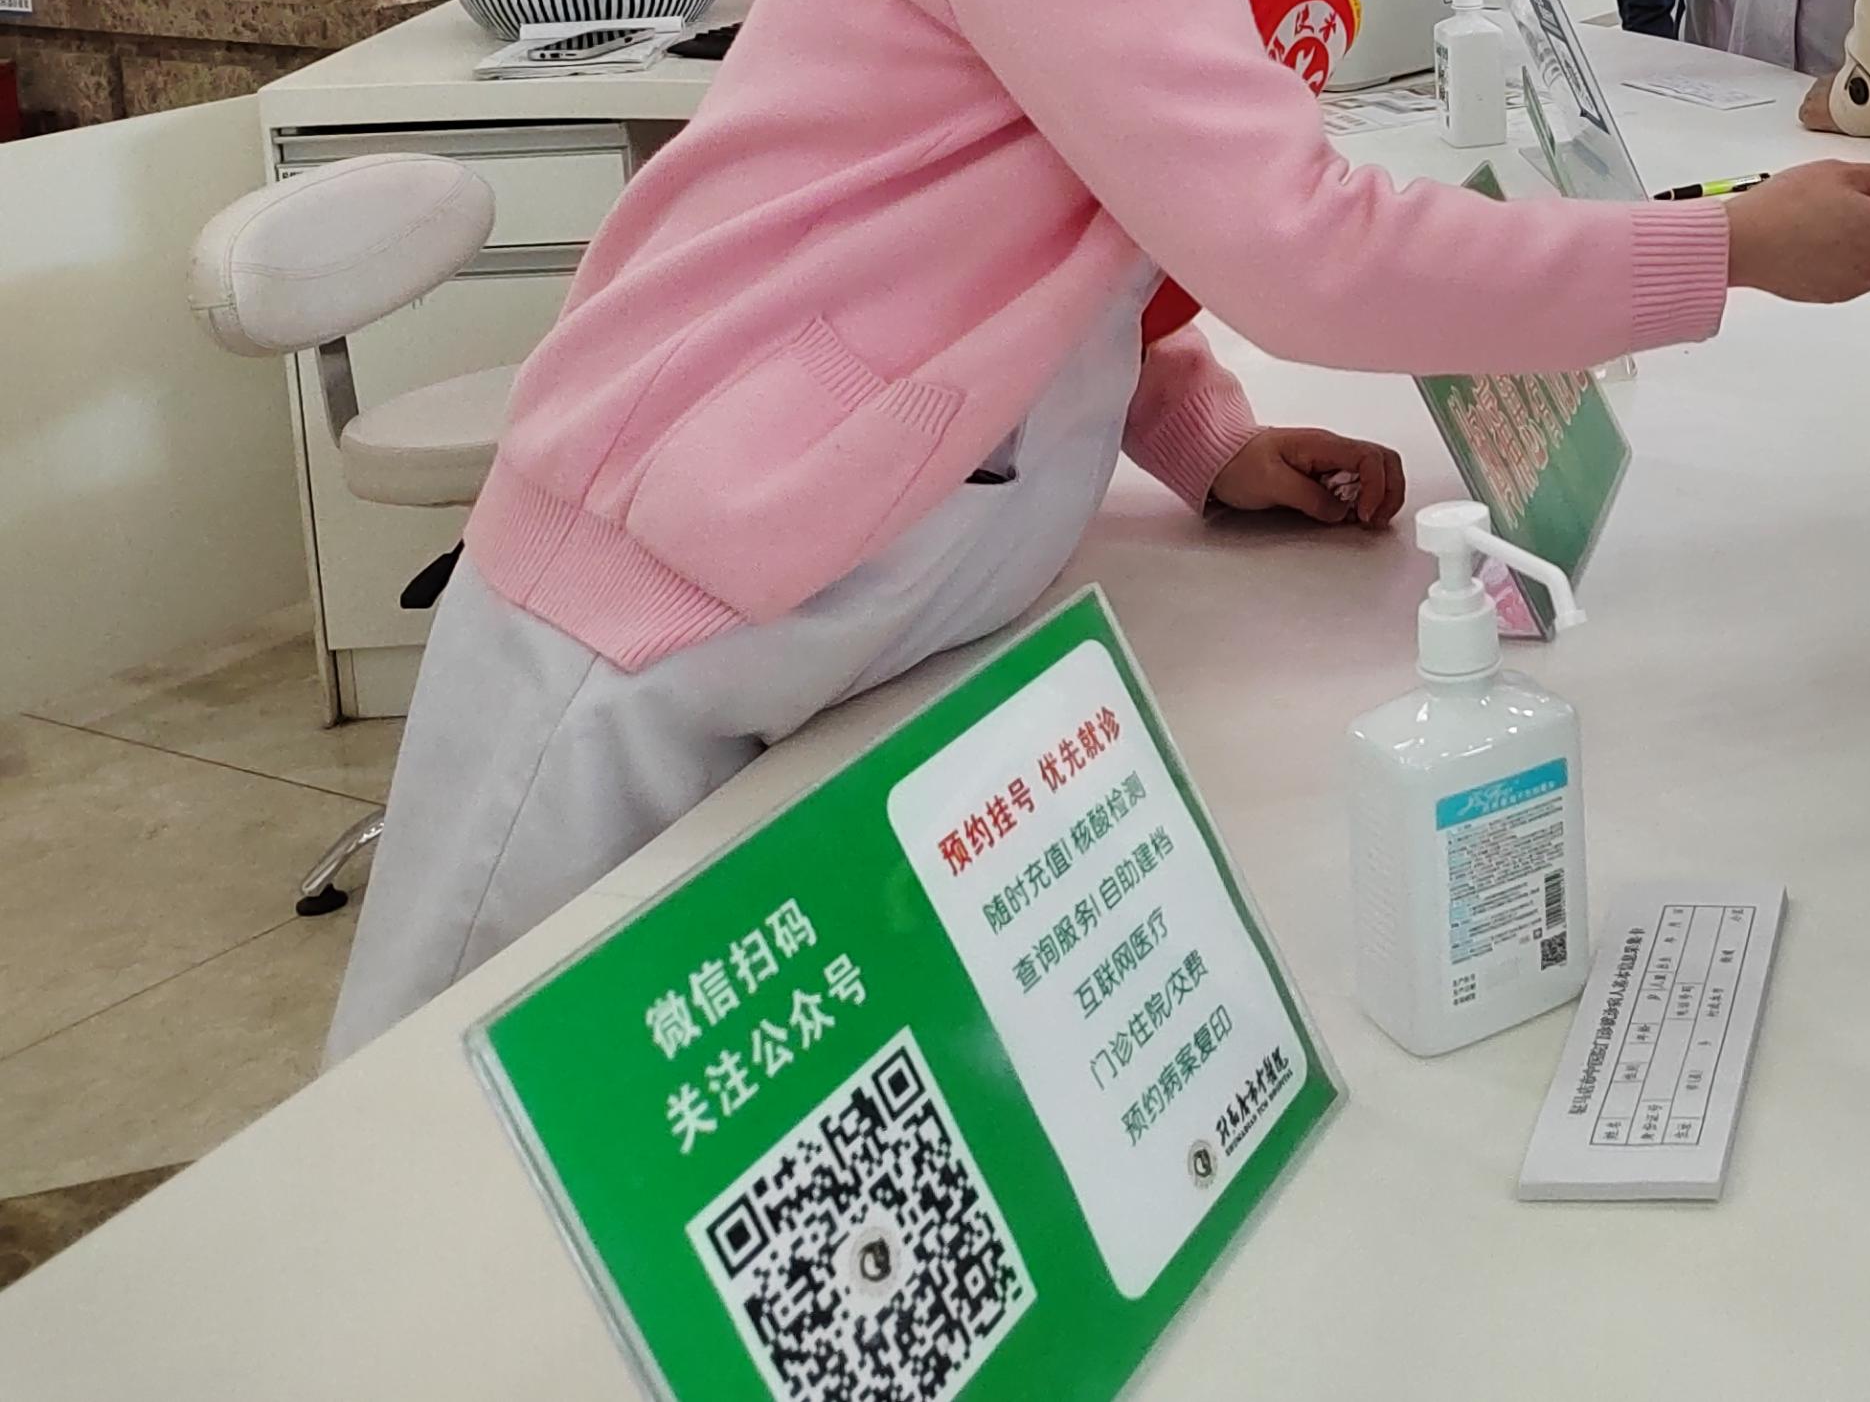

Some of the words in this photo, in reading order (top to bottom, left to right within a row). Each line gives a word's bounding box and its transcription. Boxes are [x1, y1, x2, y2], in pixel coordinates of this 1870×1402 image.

[937, 776, 1036, 877] 预约挂号
[1037, 705, 1122, 794] 优先就诊
[1070, 770, 1147, 855] 核酸检测
[1099, 825, 1175, 911] 自助建档
[645, 897, 818, 1061] 微信扫码
[1073, 906, 1169, 1020] 互联网医疗
[1089, 949, 1209, 1091] 门诊住院/交费
[666, 952, 868, 1155] 关注公众号
[1120, 1003, 1233, 1147] 预约病案复印
